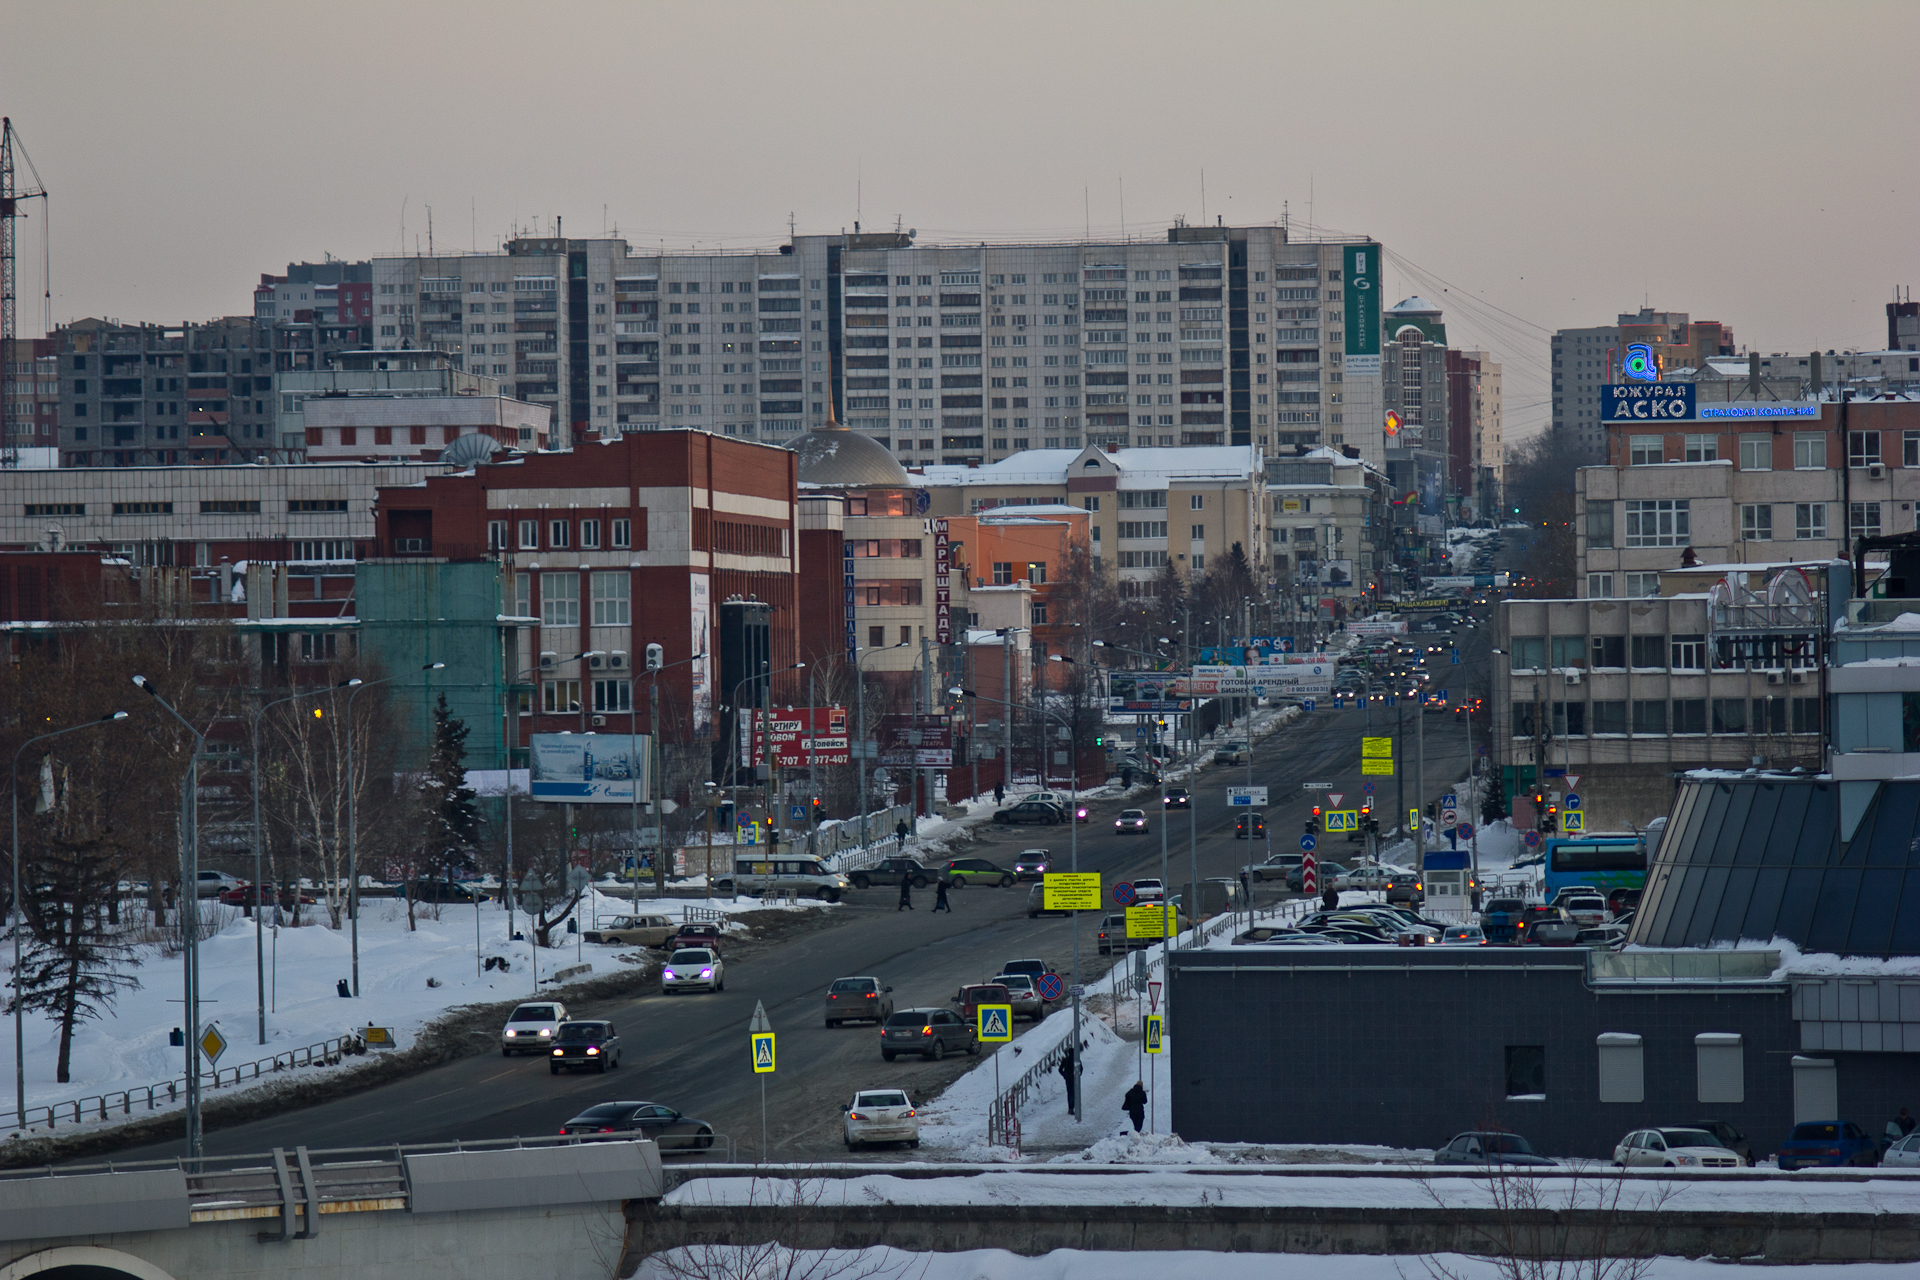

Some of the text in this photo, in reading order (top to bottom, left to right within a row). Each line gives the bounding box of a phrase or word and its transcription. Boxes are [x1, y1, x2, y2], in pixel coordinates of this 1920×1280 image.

[1613, 385, 1686, 398] ЮЖУРАЛ
[1613, 399, 1687, 418] АСКО
[1701, 406, 1815, 418] СТРАХОВАЯ КОМПАНИЯ
[924, 518, 938, 534] ДК
[936, 520, 950, 644] МАРКШТАДТ
[1221, 678, 1299, 686] ГОТОВЫЙ АРЕНДНЫЙ
[757, 722, 799, 732] КАРТИРУ
[756, 745, 782, 755] ДМЕ
